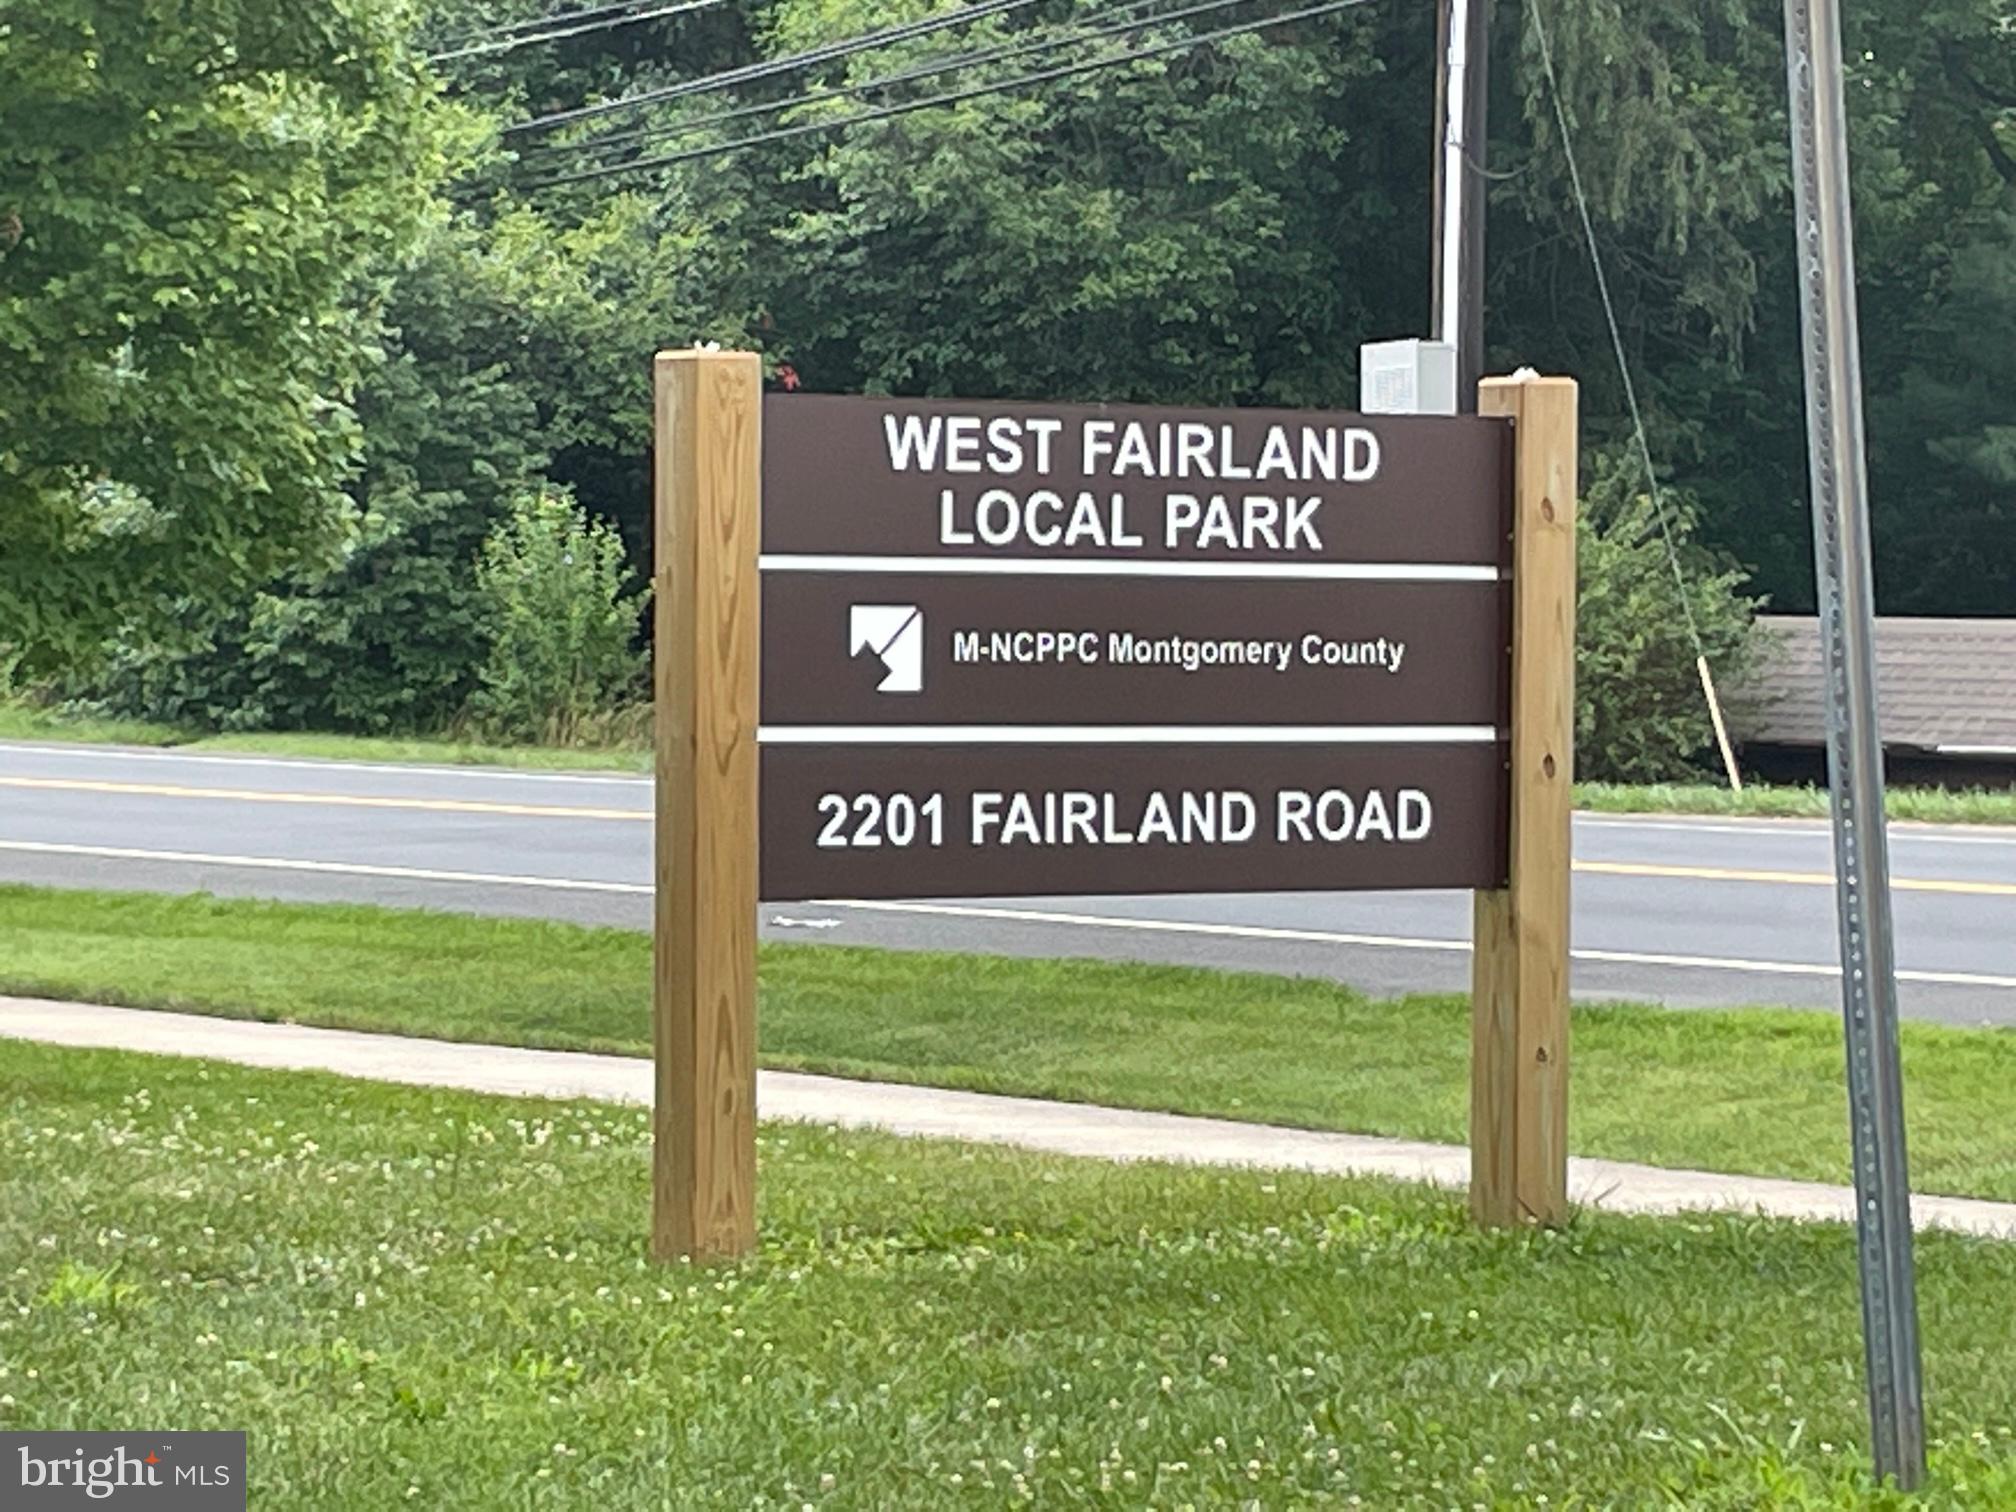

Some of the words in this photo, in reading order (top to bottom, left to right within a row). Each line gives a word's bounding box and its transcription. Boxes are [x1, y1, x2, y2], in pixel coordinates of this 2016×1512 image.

[884, 414, 1062, 475] WEST
[1083, 419, 1382, 482] FAIRLAND
[940, 489, 1143, 548] LOCAL
[1165, 494, 1323, 551] PARK
[953, 631, 1099, 664] M-NCPPC
[1108, 632, 1293, 671] Montgomery
[1301, 634, 1405, 673] County
[817, 792, 943, 847] 2201
[972, 791, 1256, 845] FAIRLAND
[1277, 789, 1432, 842] ROAD
